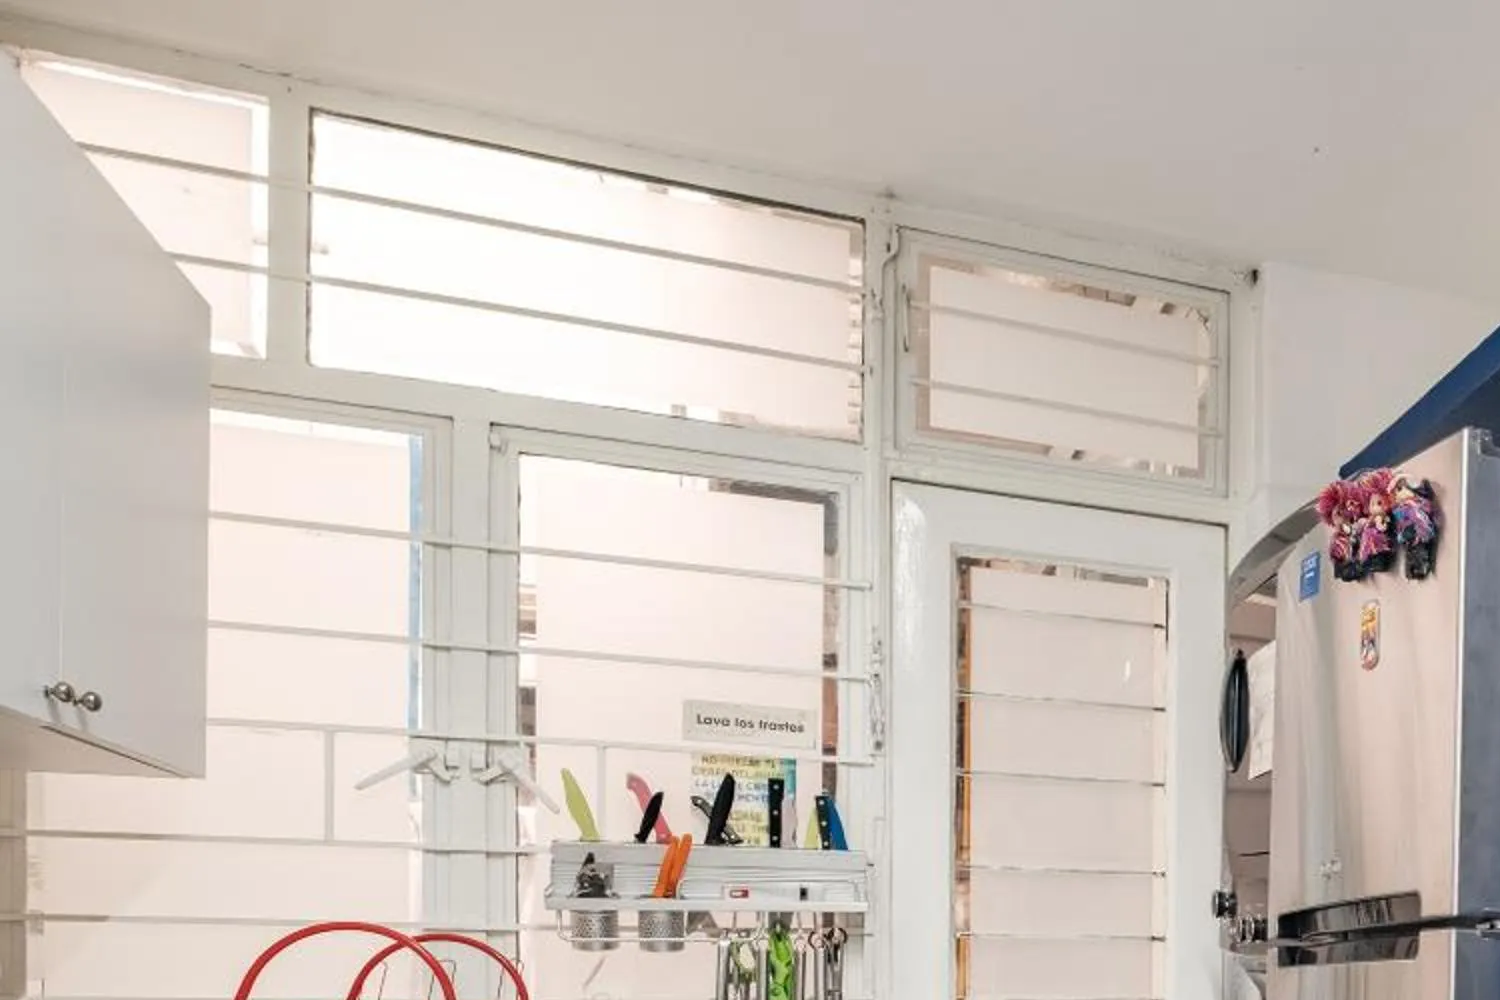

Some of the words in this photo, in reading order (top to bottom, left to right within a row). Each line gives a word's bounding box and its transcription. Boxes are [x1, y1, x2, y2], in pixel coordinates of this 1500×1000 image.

[696, 713, 730, 727] Lava
[734, 717, 755, 730] los
[758, 719, 805, 734] trastes
